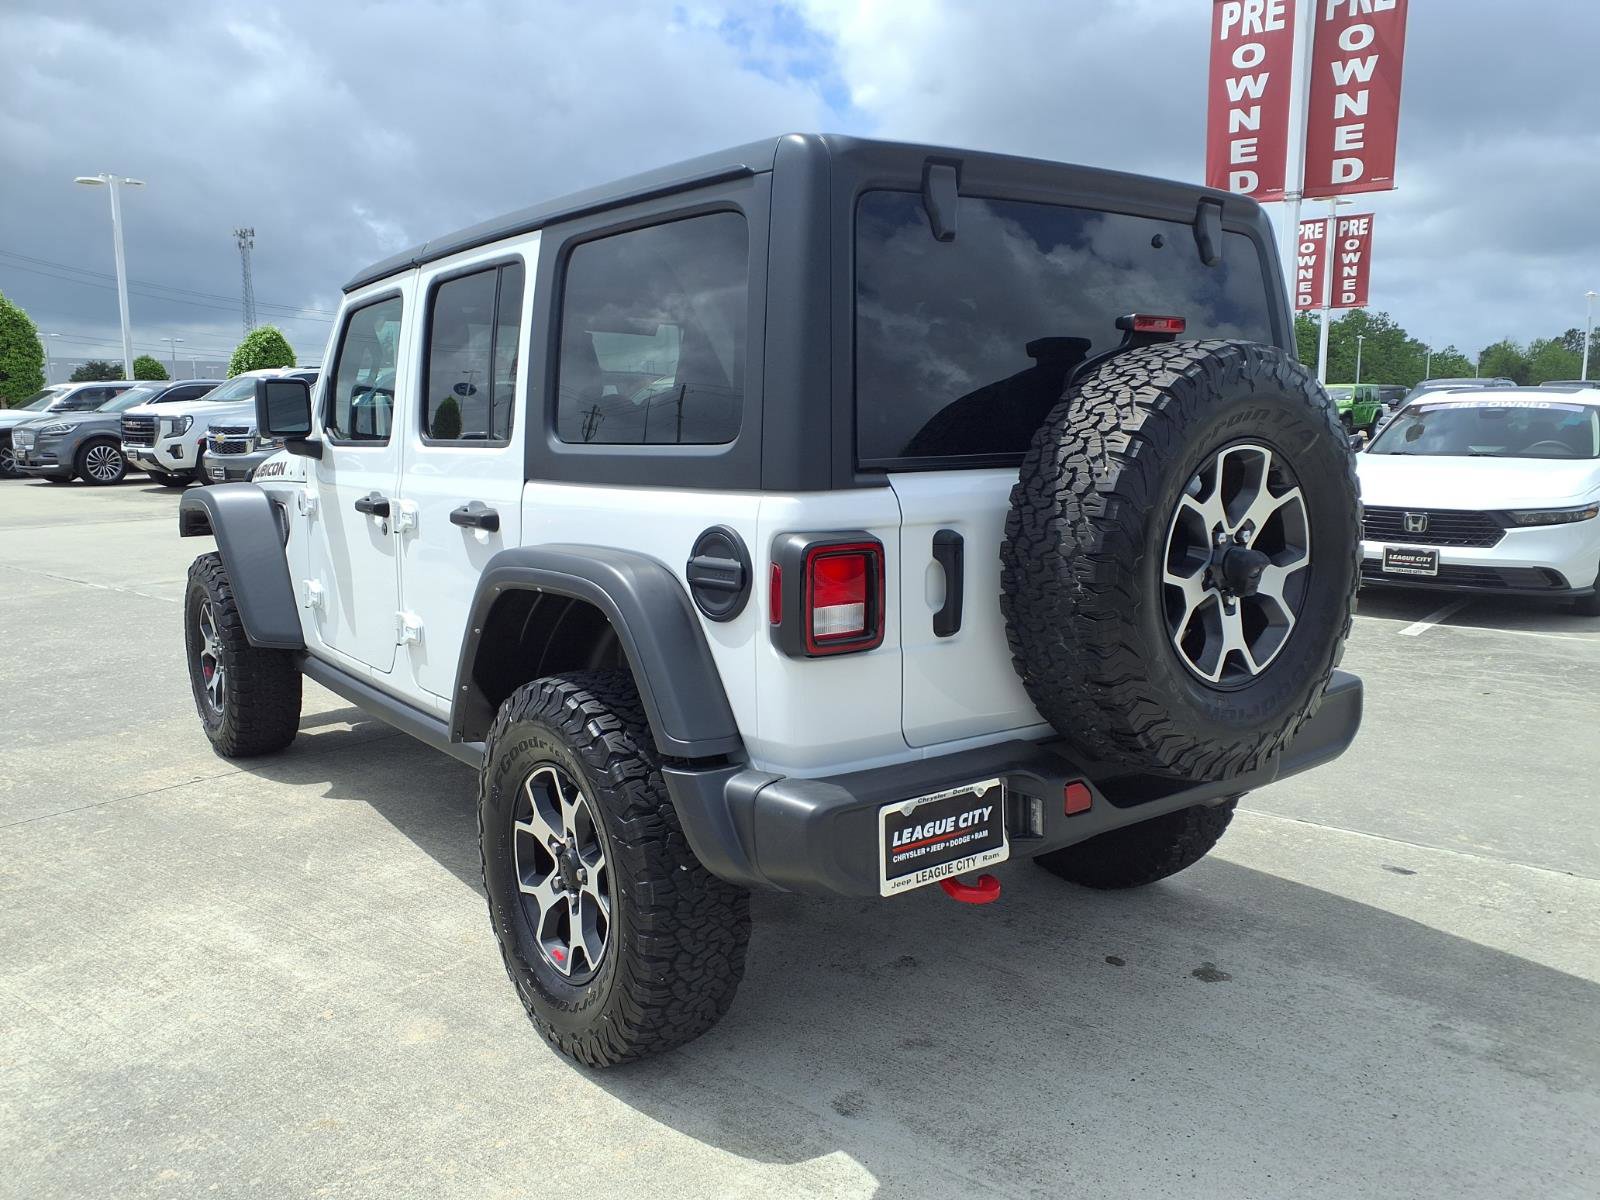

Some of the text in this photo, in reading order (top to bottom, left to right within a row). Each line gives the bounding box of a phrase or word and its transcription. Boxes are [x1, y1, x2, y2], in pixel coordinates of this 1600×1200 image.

[1220, 0, 1286, 40] PRE
[1225, 42, 1270, 195] OWNED
[1330, 23, 1379, 184] OWNED
[1339, 218, 1369, 237] PRE
[1297, 242, 1317, 306] OWNED
[1341, 239, 1361, 303] OWNED
[255, 461, 287, 478] UBICON
[917, 785, 974, 804] Chrysler Dodge
[892, 806, 993, 847] LEAGUE CITY
[892, 829, 989, 863] CHRYSLER JEEP DODGE RAM
[891, 851, 1000, 889] Jeep LEAGUE CITY Ram
